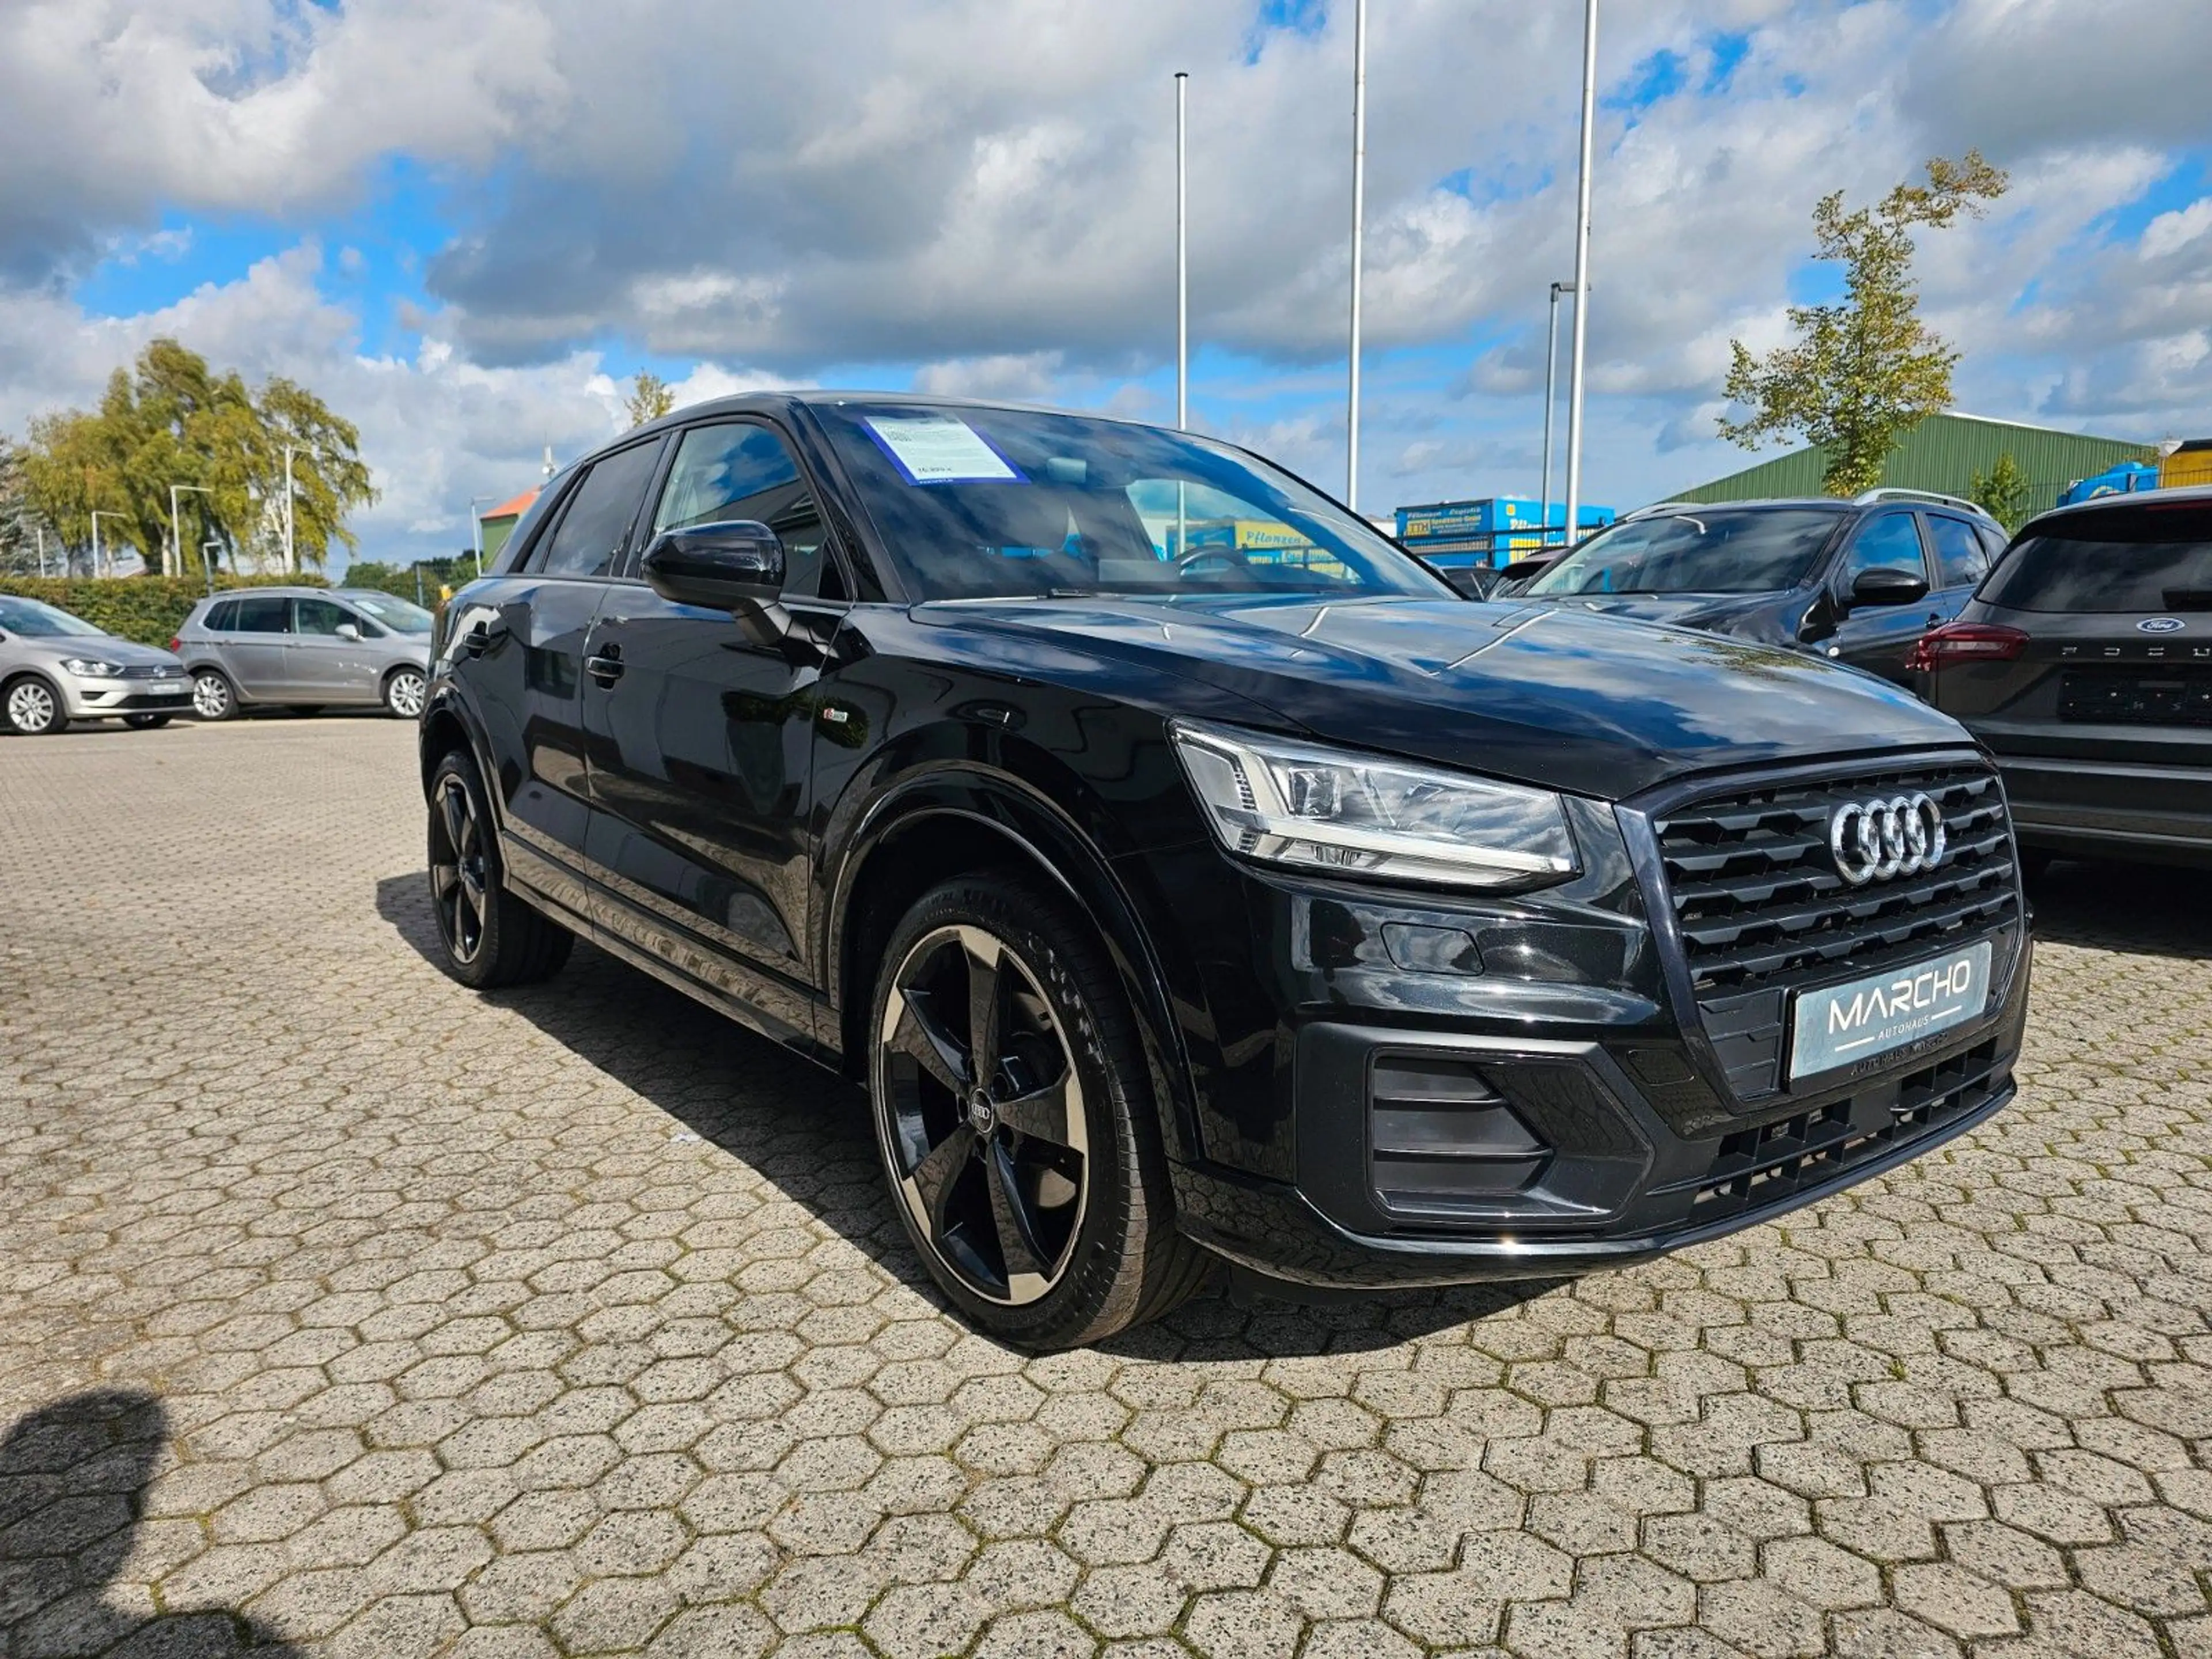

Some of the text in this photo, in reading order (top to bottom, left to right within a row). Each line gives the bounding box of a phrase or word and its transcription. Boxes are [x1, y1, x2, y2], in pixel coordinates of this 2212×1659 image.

[2147, 620, 2174, 630] Ford
[1828, 959, 1971, 1035] MARCHO
[1878, 1016, 1930, 1041] AUTOHAUS
